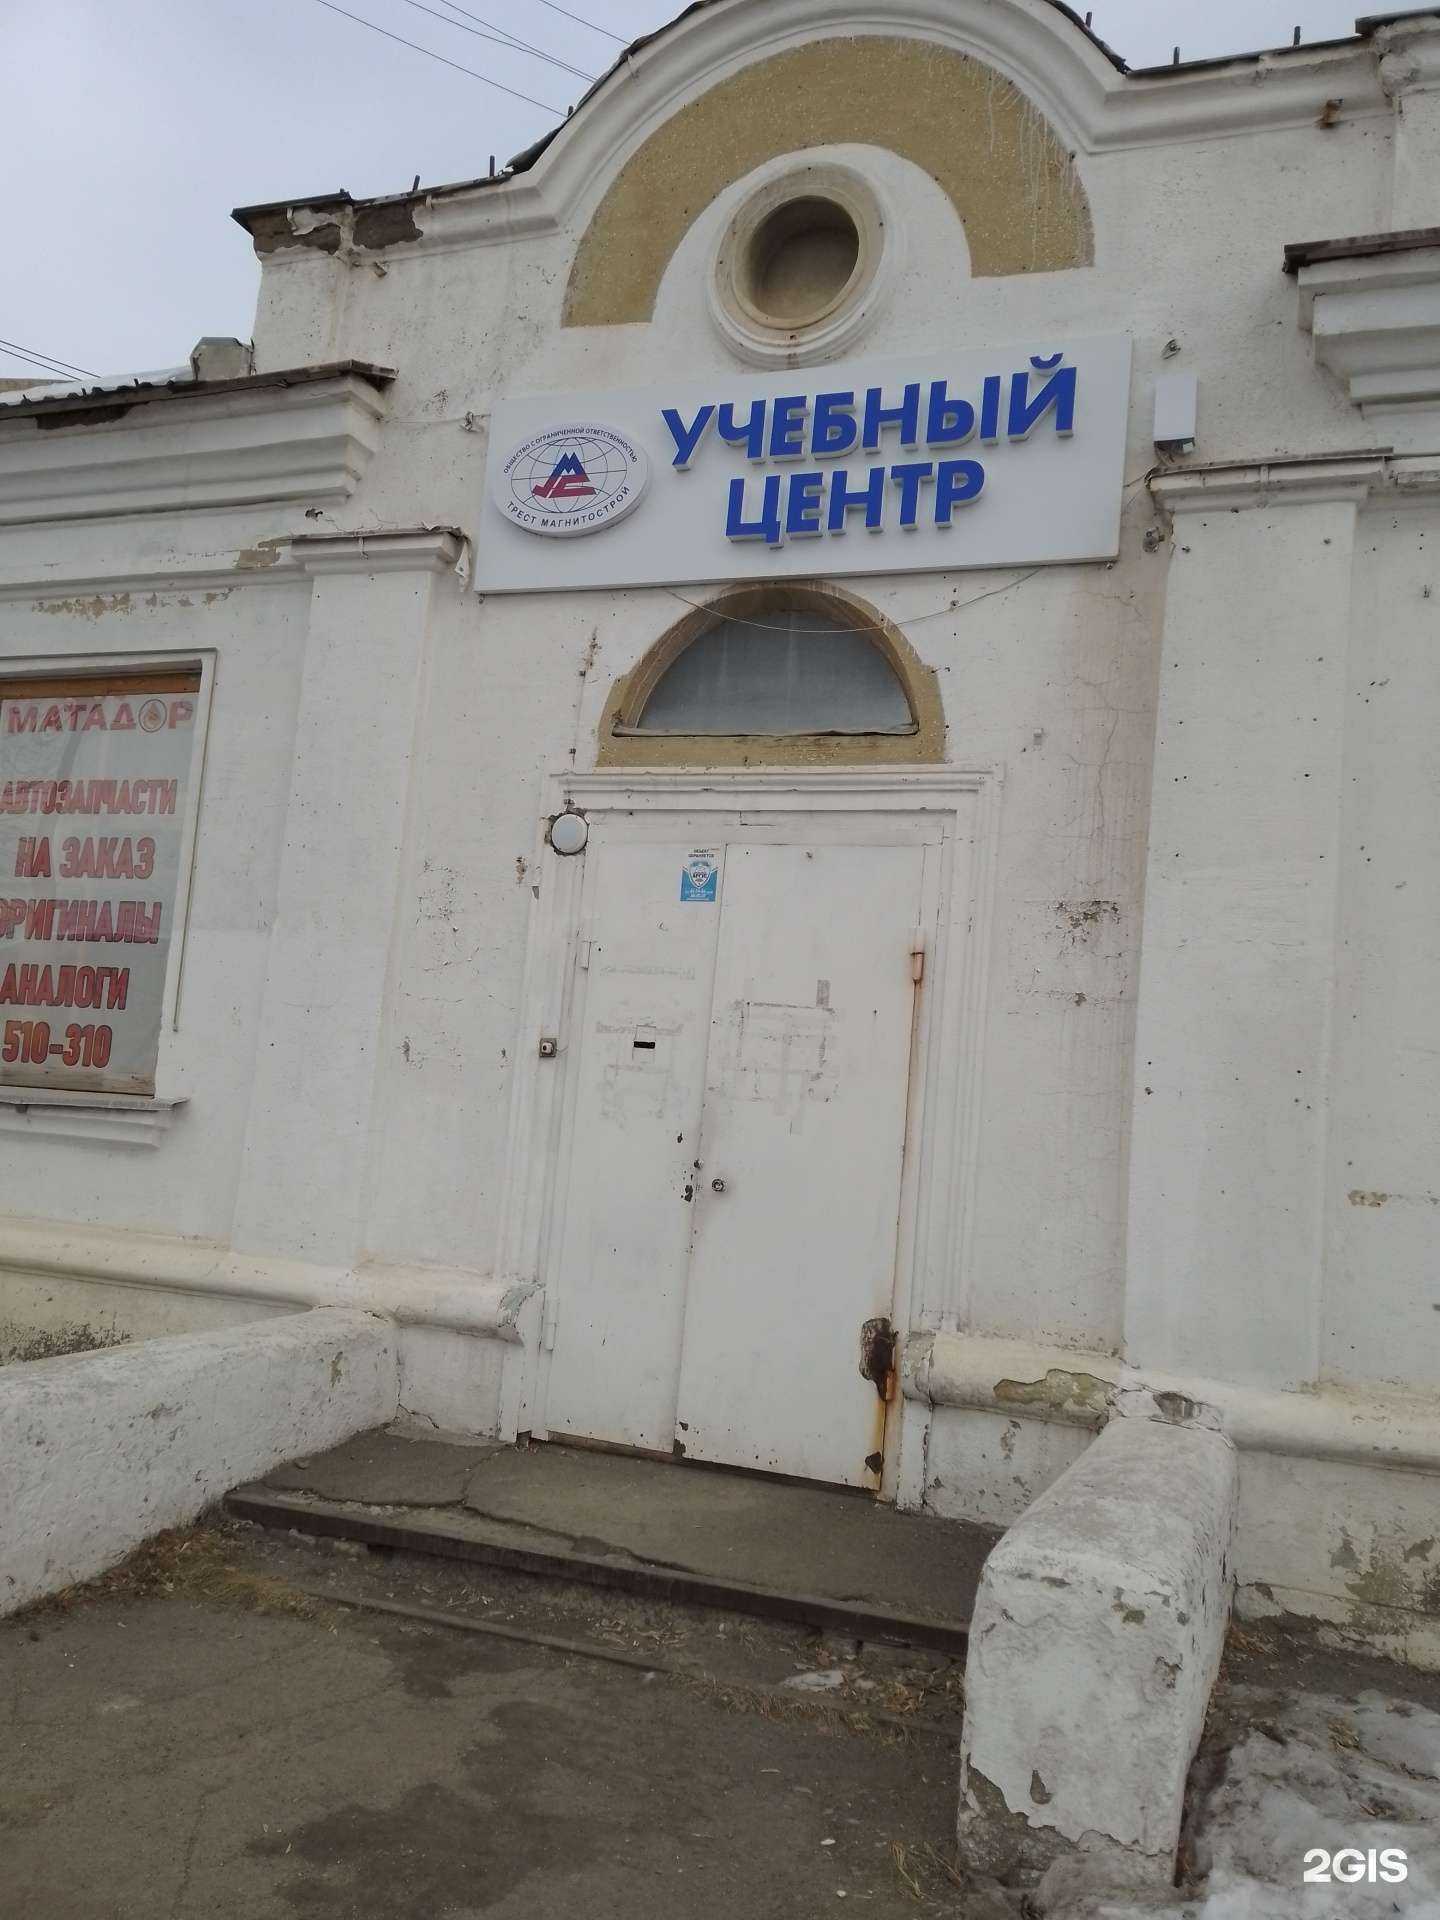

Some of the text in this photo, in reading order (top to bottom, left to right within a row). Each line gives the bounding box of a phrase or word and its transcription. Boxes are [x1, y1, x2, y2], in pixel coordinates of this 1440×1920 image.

[661, 353, 1077, 470] УЧЕБНЫЙ
[503, 444, 531, 474] ОБЩЕСТВО
[535, 428, 585, 445] ОГРАНИЧЕННОЙ
[585, 428, 638, 463] ОТВЕТСТВЕННОСТЬЮ
[506, 486, 630, 527] ТРЕСТ МАГНИТОСТРОЙ
[725, 459, 985, 548] ЦЕНТР
[14, 836, 156, 879] НА ЗАКАЗ
[0, 963, 131, 1010] АНАЛОГИ
[2, 1020, 113, 1068] 510-310
